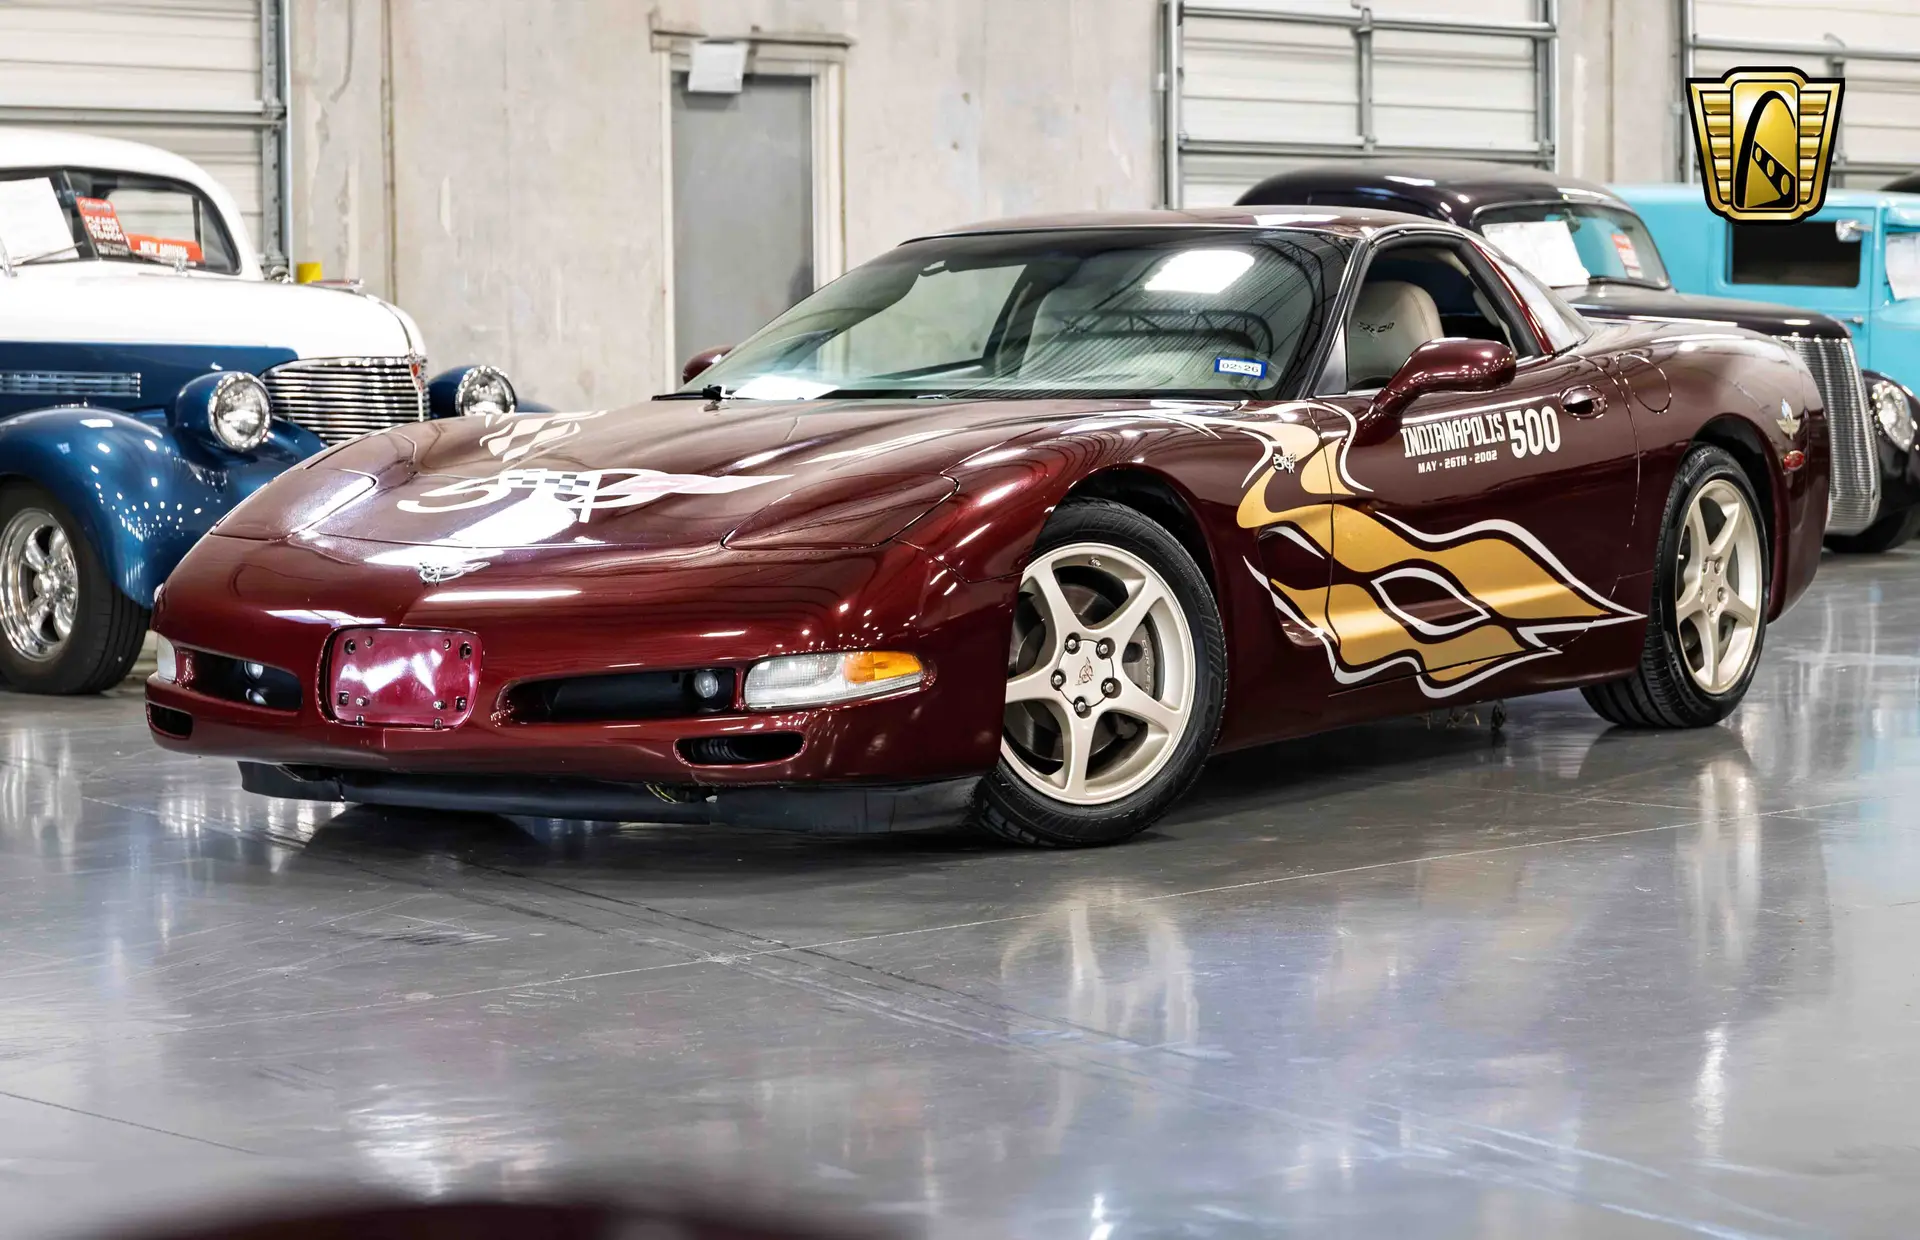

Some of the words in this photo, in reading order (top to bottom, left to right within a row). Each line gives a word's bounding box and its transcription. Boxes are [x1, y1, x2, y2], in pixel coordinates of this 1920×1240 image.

[92, 230, 125, 241] TOUCH
[140, 240, 158, 256] NEW
[1400, 413, 1506, 458] INDIANAPOLIS
[1505, 406, 1561, 459] 500
[1418, 460, 1437, 473] MAY
[1444, 455, 1467, 469] 26TH
[1474, 450, 1497, 464] 2002
